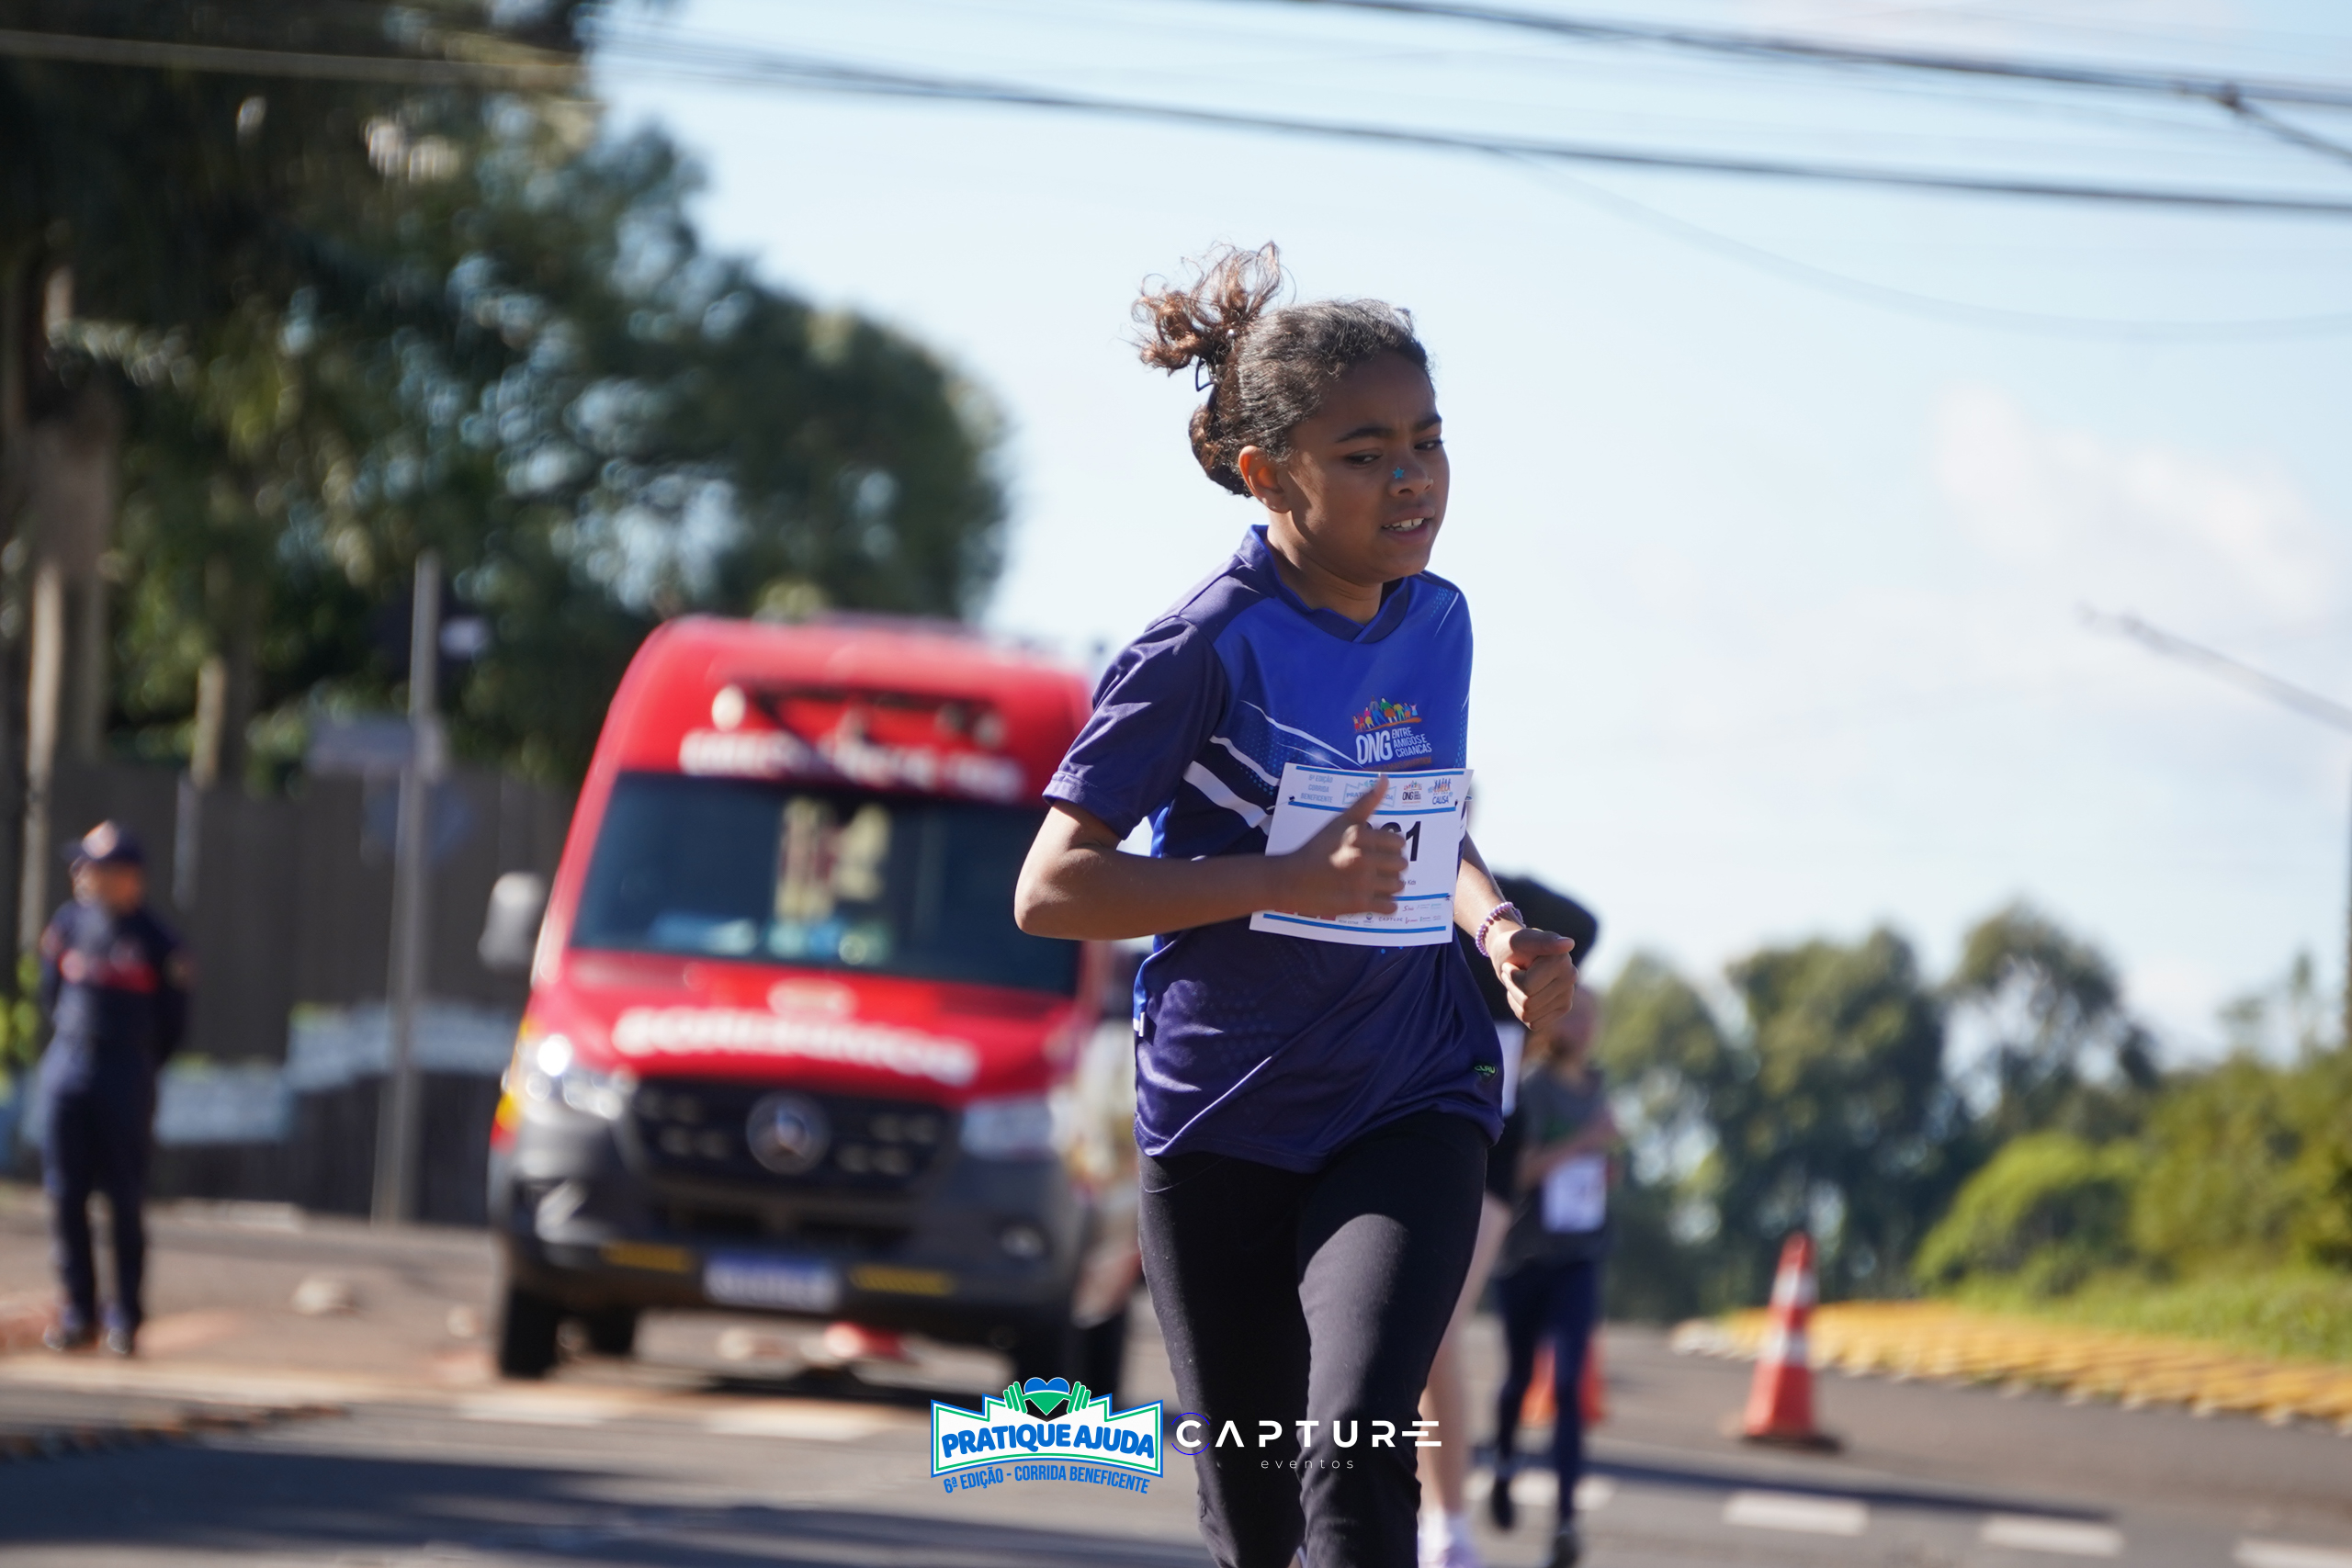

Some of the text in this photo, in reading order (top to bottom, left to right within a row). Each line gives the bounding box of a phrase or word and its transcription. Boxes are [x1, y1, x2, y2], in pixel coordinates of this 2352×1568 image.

[1392, 727, 1414, 739] ENTRE
[1355, 730, 1393, 765] ONG
[1402, 791, 1414, 800] ONG
[1432, 795, 1449, 805] CAUSA
